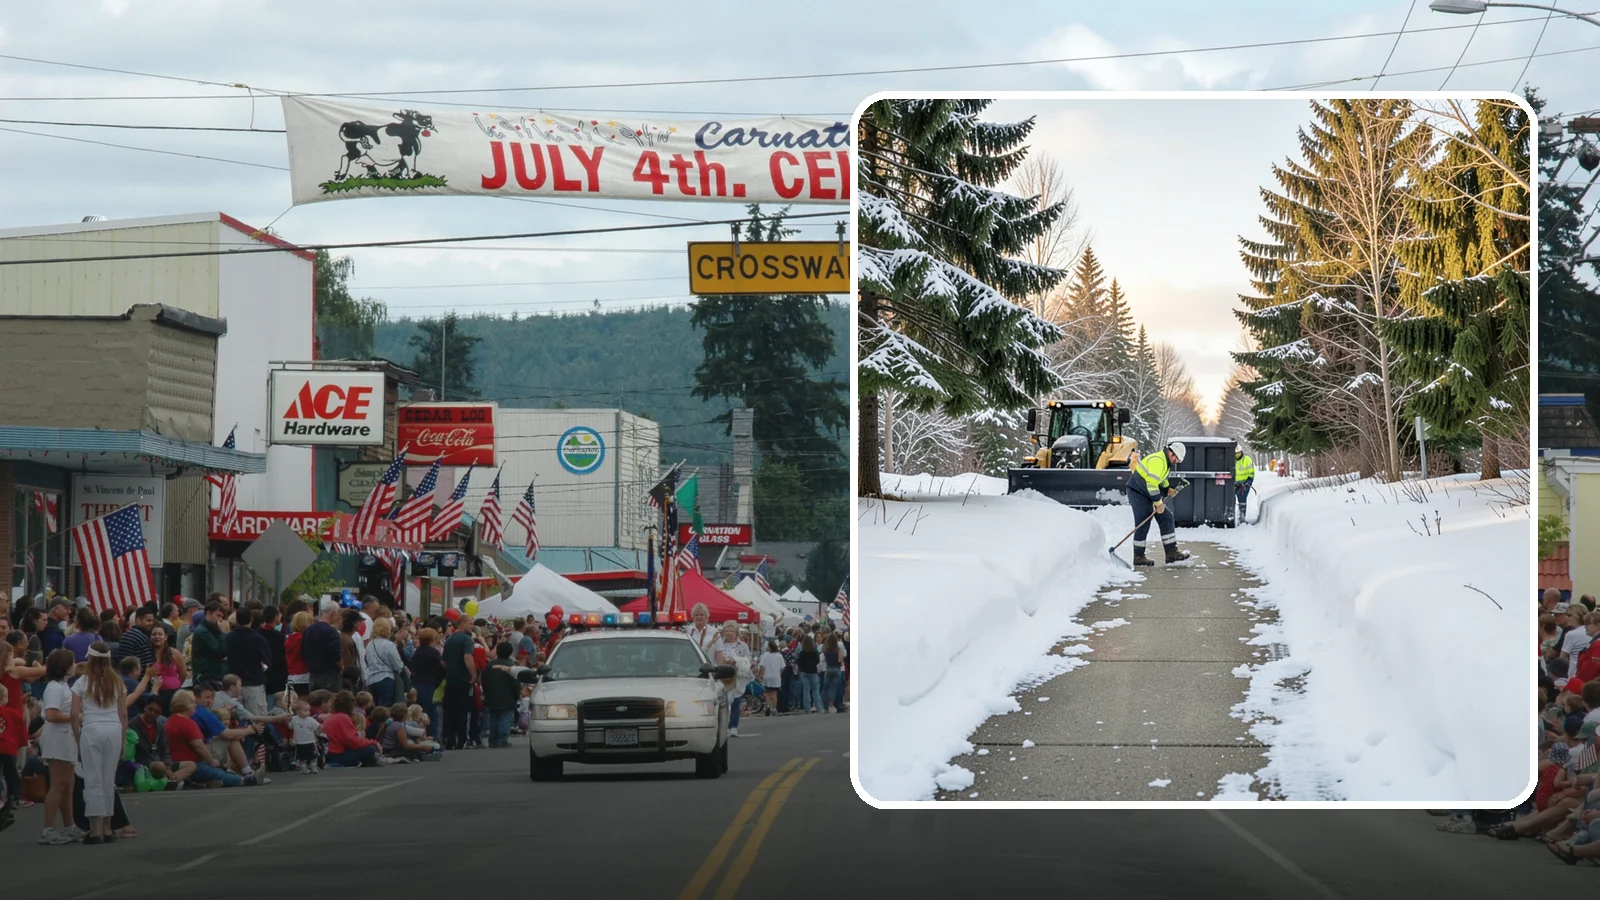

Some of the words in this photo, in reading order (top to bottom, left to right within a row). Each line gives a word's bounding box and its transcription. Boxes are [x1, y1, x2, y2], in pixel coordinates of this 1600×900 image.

[481, 140, 605, 193] JULY
[632, 149, 747, 198] 4th.
[696, 253, 850, 280] CROSSWA
[282, 379, 374, 420] ACE
[405, 409, 453, 422] CEDAR
[460, 409, 486, 422] LOG
[283, 420, 371, 437] Hardware
[416, 427, 477, 447] Coca-Cola
[353, 466, 384, 480] Simpl
[83, 484, 94, 494] St.
[95, 484, 124, 495] Vincent
[126, 485, 136, 495] de
[137, 485, 155, 495] Paul
[212, 515, 331, 536] HARDARE
[687, 526, 742, 536] CRNATION
[699, 535, 730, 544] GLASS
